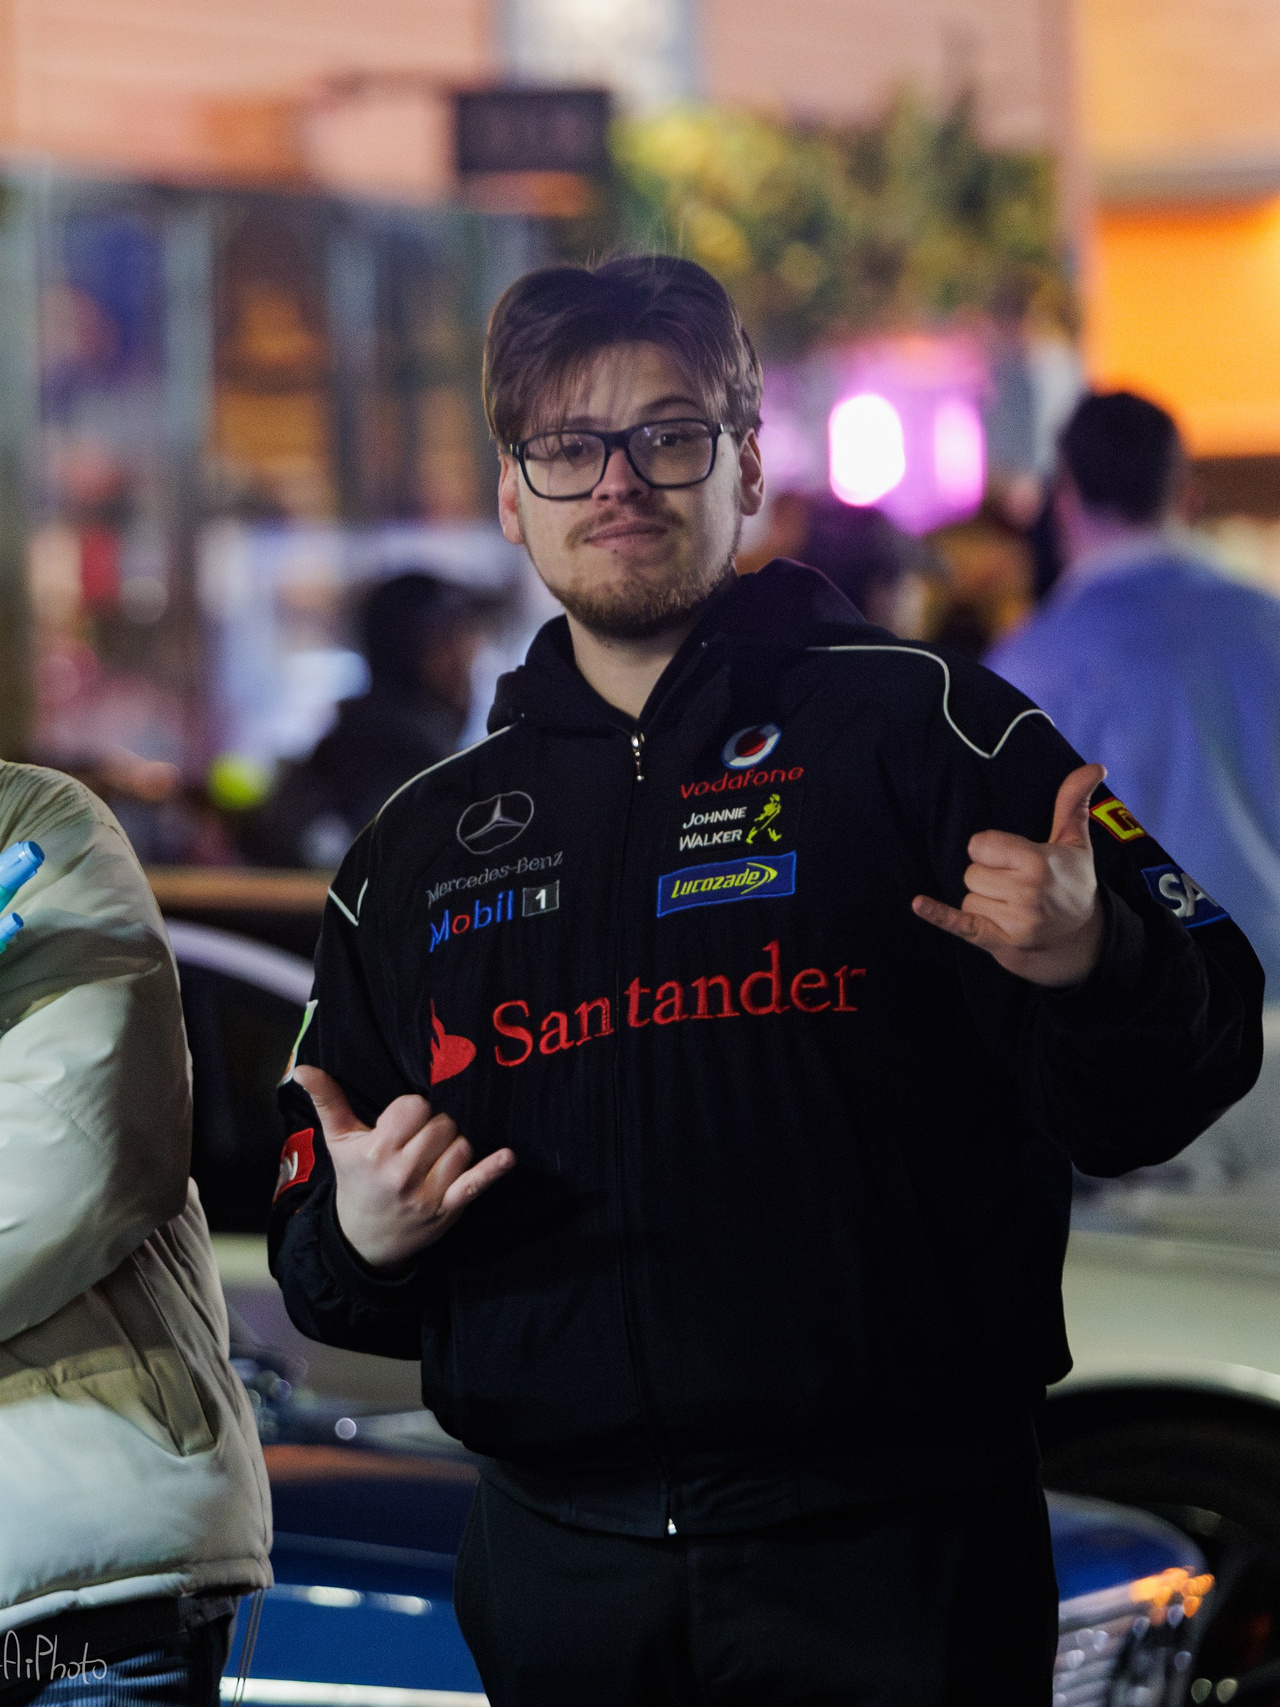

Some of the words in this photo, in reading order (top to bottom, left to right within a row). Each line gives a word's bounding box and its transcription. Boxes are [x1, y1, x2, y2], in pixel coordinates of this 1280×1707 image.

[680, 766, 805, 799] vodafone
[682, 806, 748, 830] JOHNNIE
[679, 829, 743, 851] WALKER
[426, 850, 563, 909] Mercedes-Benz
[671, 867, 761, 899] Lucozade
[429, 889, 515, 954] Mobil
[535, 888, 547, 910] 1
[492, 940, 867, 1067] Santander
